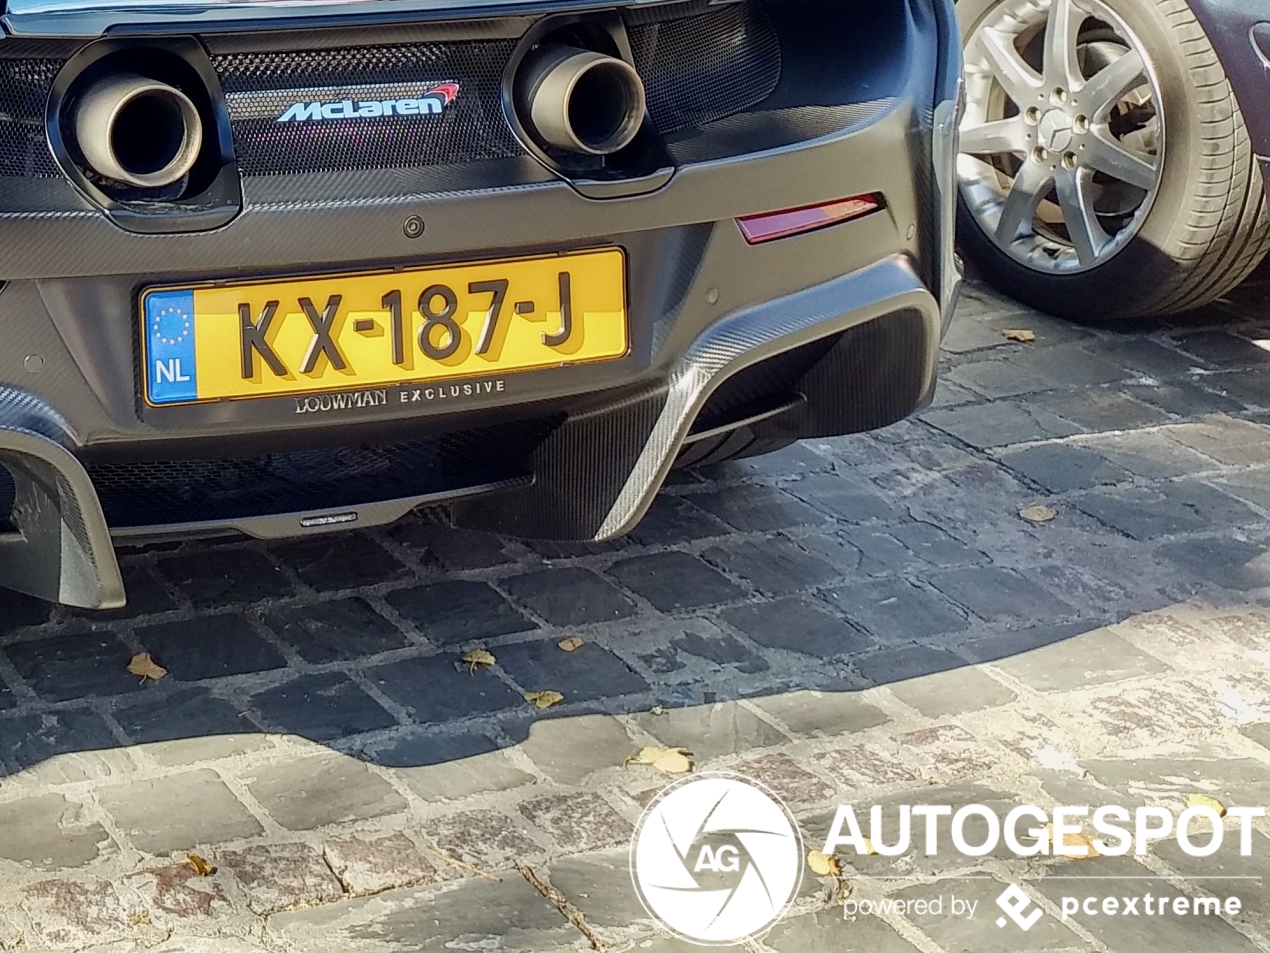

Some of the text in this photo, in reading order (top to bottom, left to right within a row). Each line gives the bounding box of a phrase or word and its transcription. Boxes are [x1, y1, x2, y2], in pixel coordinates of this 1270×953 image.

[276, 98, 443, 123] McLaren
[237, 271, 573, 380] KX-187-J
[154, 358, 191, 384] NL
[294, 379, 506, 414] LOUWMAN EXCLUSIVE
